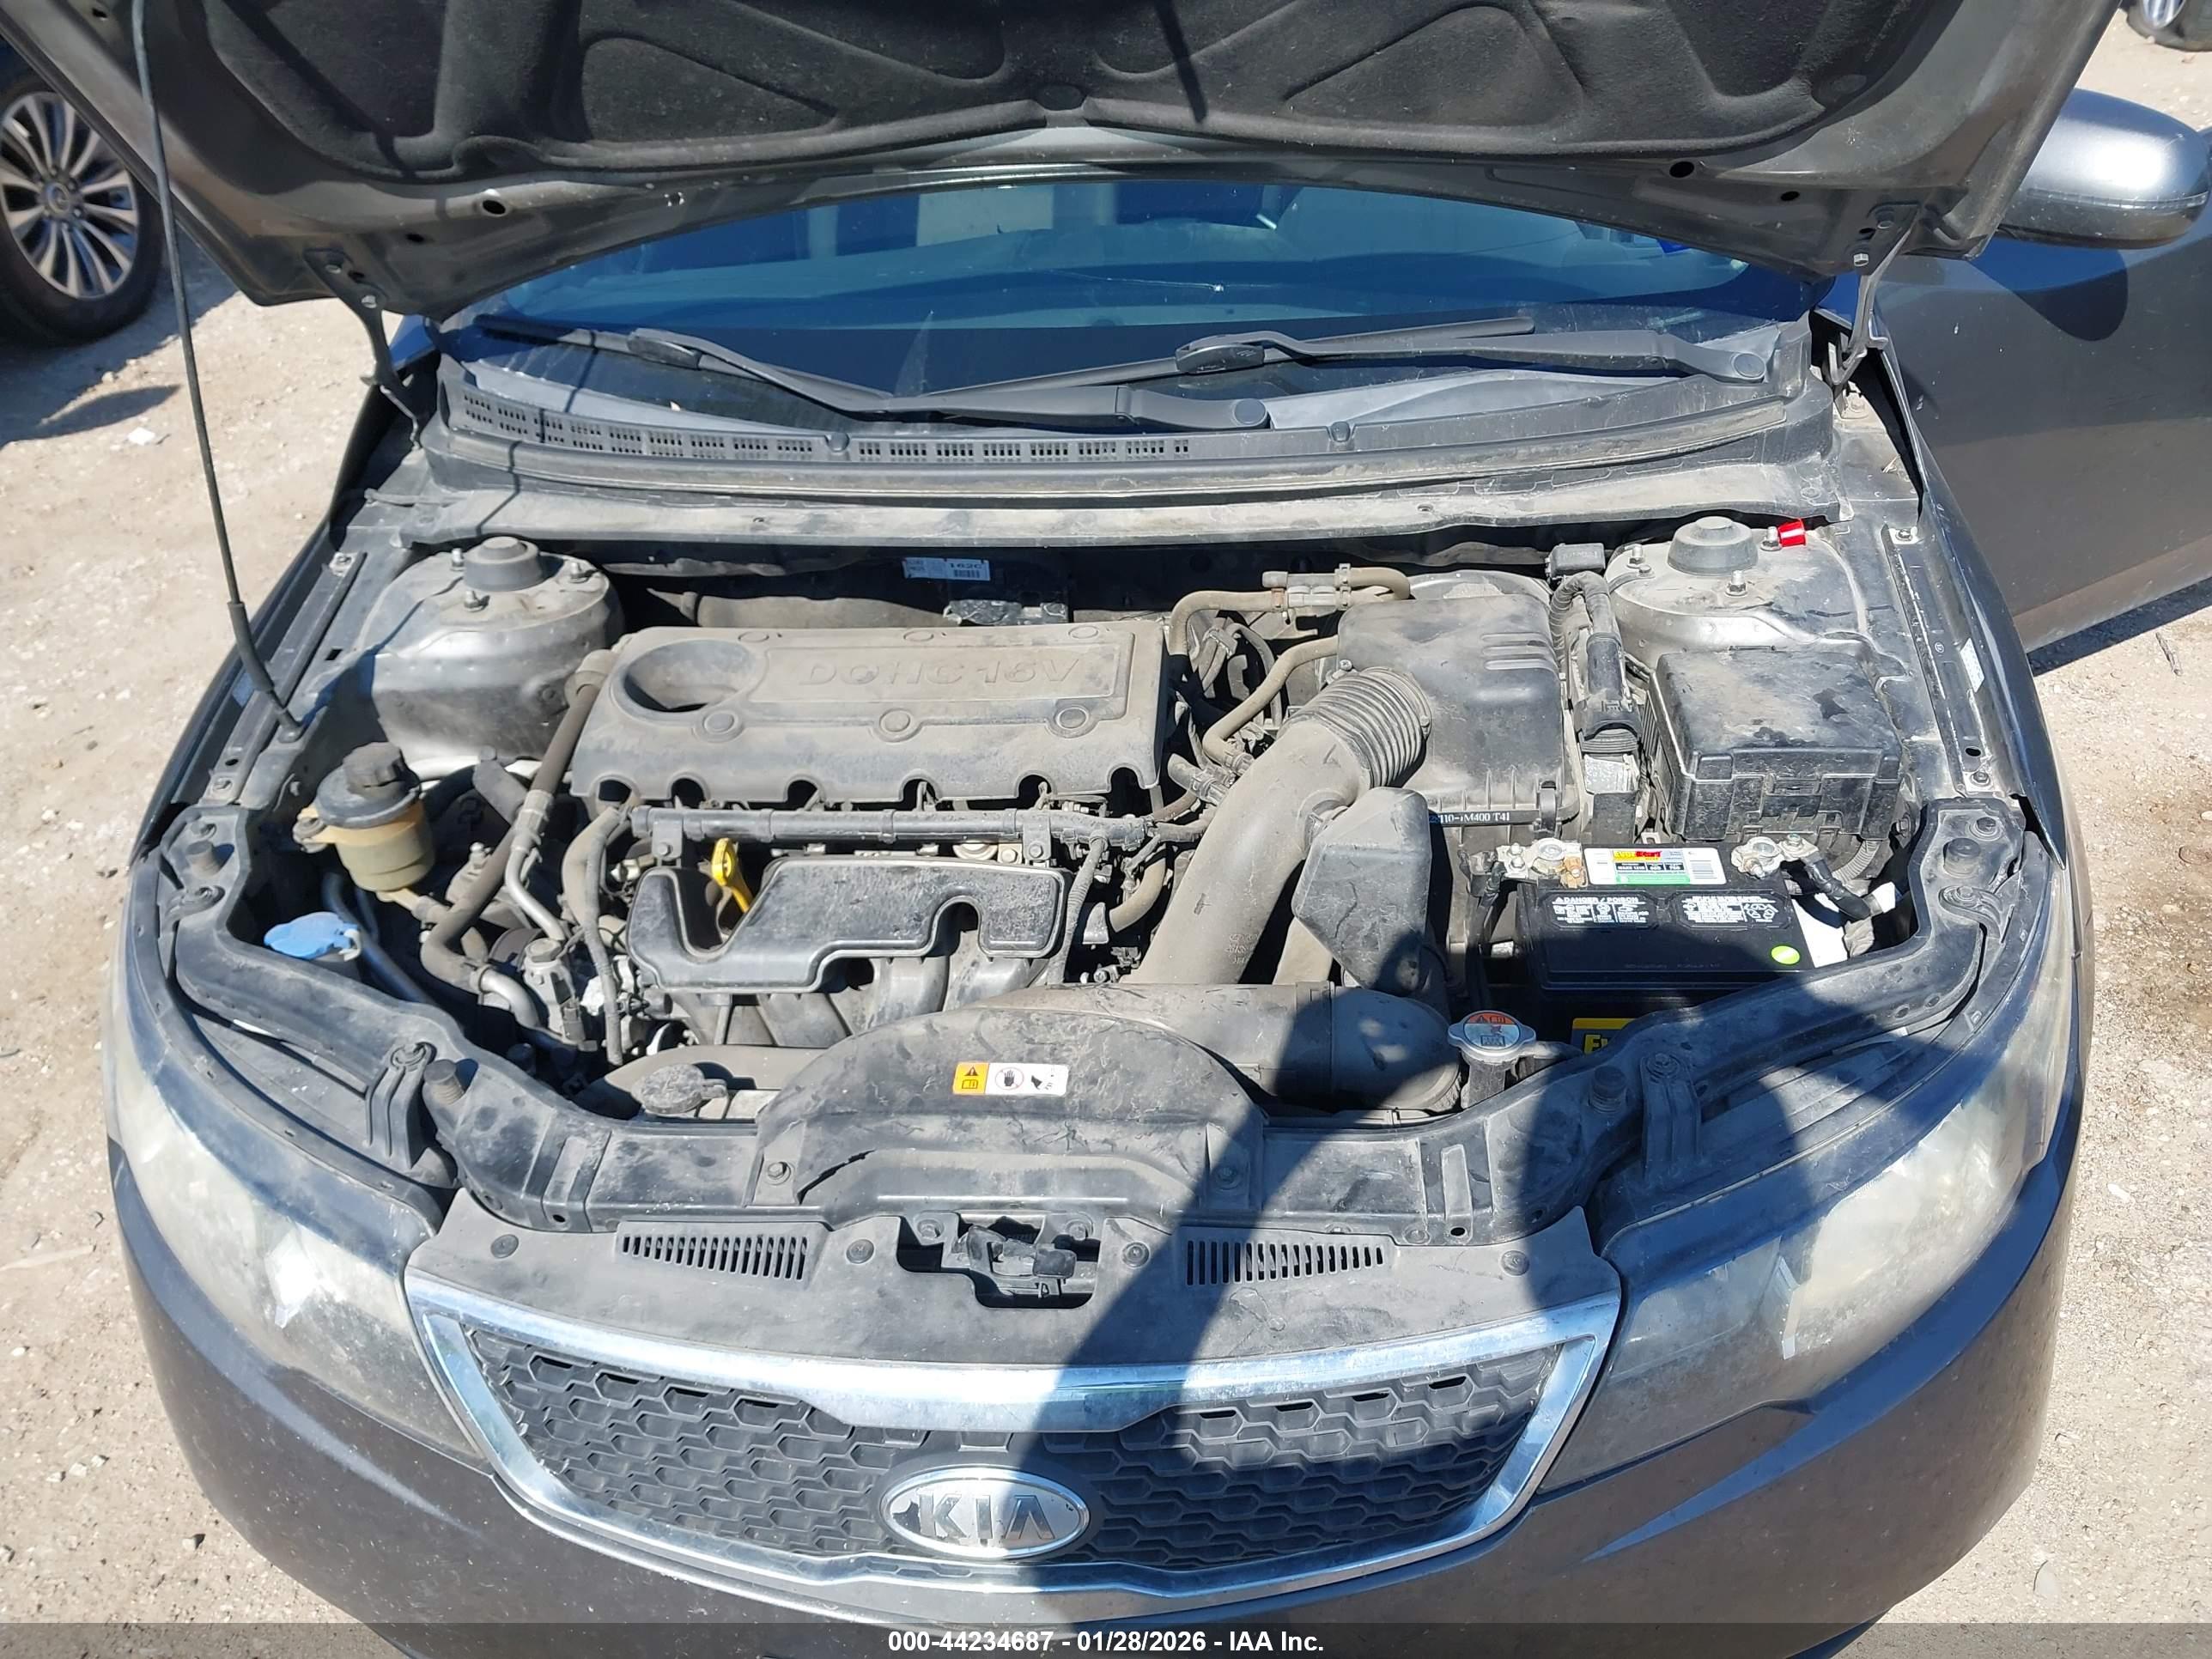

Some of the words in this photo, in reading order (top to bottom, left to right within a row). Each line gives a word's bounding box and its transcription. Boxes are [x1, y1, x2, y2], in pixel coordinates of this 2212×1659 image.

[799, 657, 964, 685] DOHC
[976, 657, 1079, 684] 16V
[917, 1489, 1055, 1540] KIA
